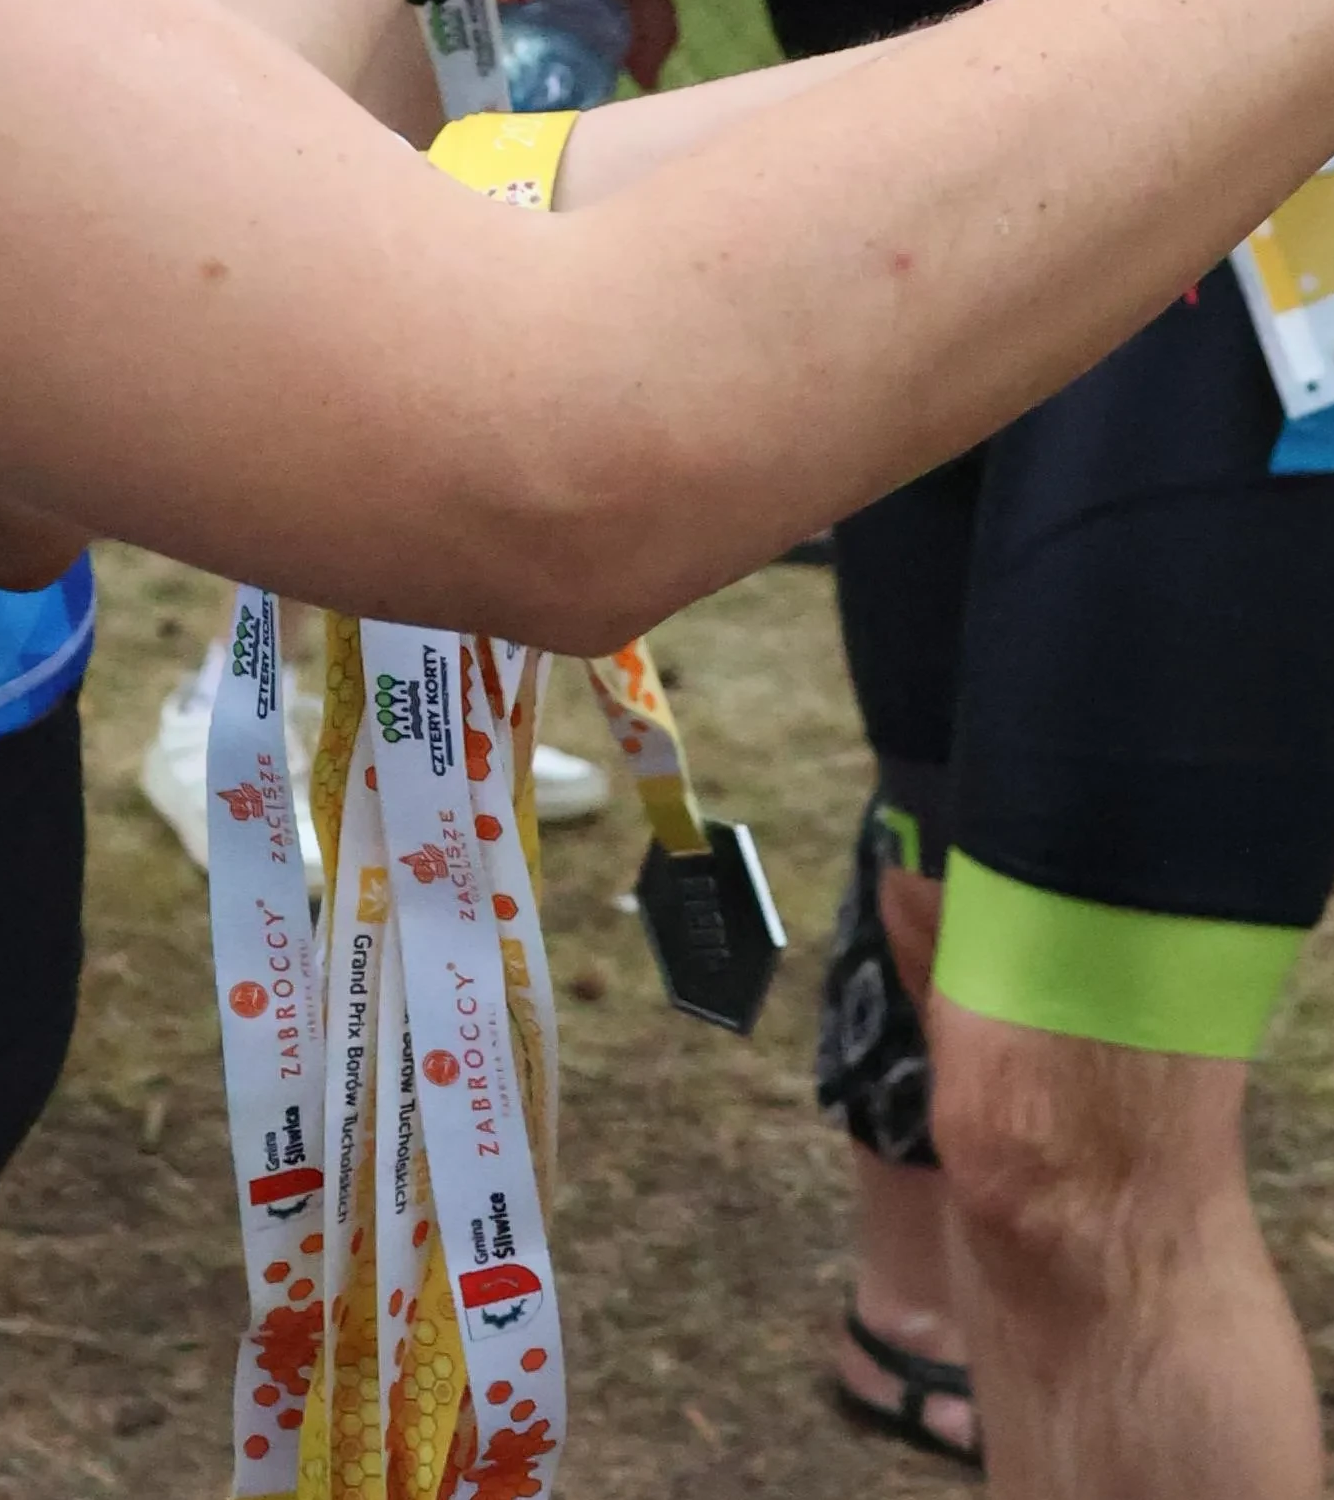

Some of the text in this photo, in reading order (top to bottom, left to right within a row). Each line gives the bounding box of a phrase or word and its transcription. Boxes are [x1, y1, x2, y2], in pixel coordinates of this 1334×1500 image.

[257, 591, 271, 720] CZTERY KORT
[422, 644, 447, 777] CZTERY KORTY
[259, 753, 287, 864] ZACISZE
[440, 809, 477, 921] ZACISZE
[263, 906, 301, 1079] ZABROCCY
[337, 933, 373, 1226] Grand Prix Borów Tucholskich
[455, 969, 500, 1157] ZABROCCY
[265, 1131, 280, 1171] Gmina
[394, 1098, 416, 1216] Tucholskich
[471, 1218, 489, 1265] Gmina
[489, 1191, 515, 1260] Śliwice
